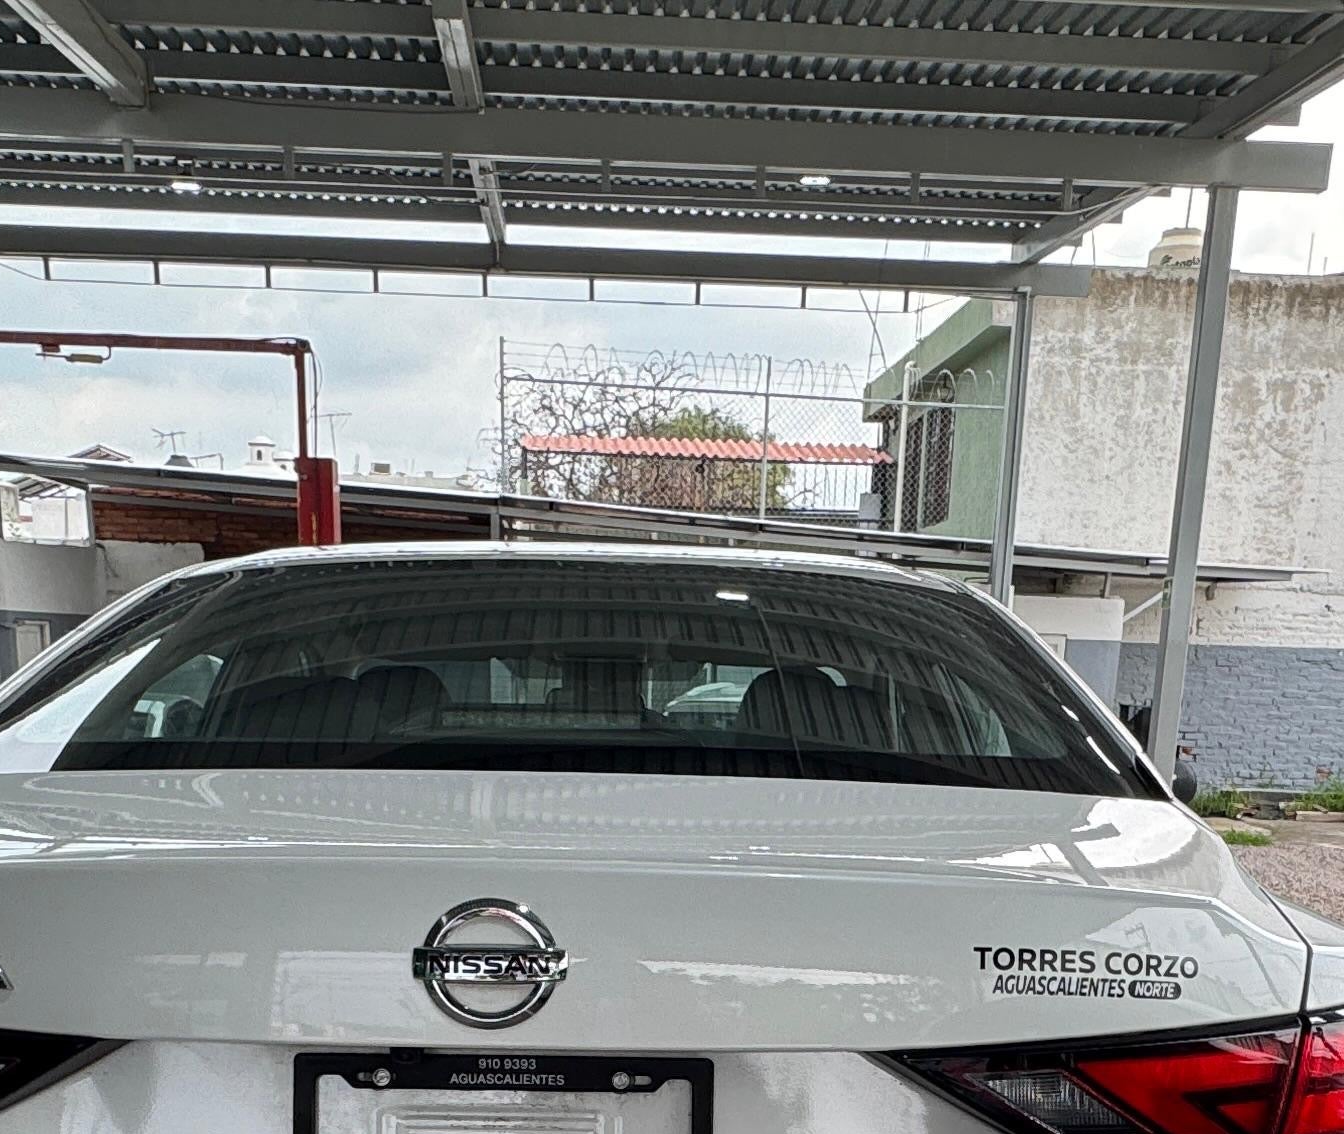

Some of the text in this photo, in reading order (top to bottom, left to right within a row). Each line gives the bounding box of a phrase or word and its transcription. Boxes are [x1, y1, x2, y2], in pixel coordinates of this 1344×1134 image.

[429, 953, 552, 976] NISSAN
[973, 946, 1199, 979] TORRES CORZO
[992, 974, 1176, 998] AGUASCALIENTES NORTE
[449, 1073, 565, 1086] AGUASCALIENTES
